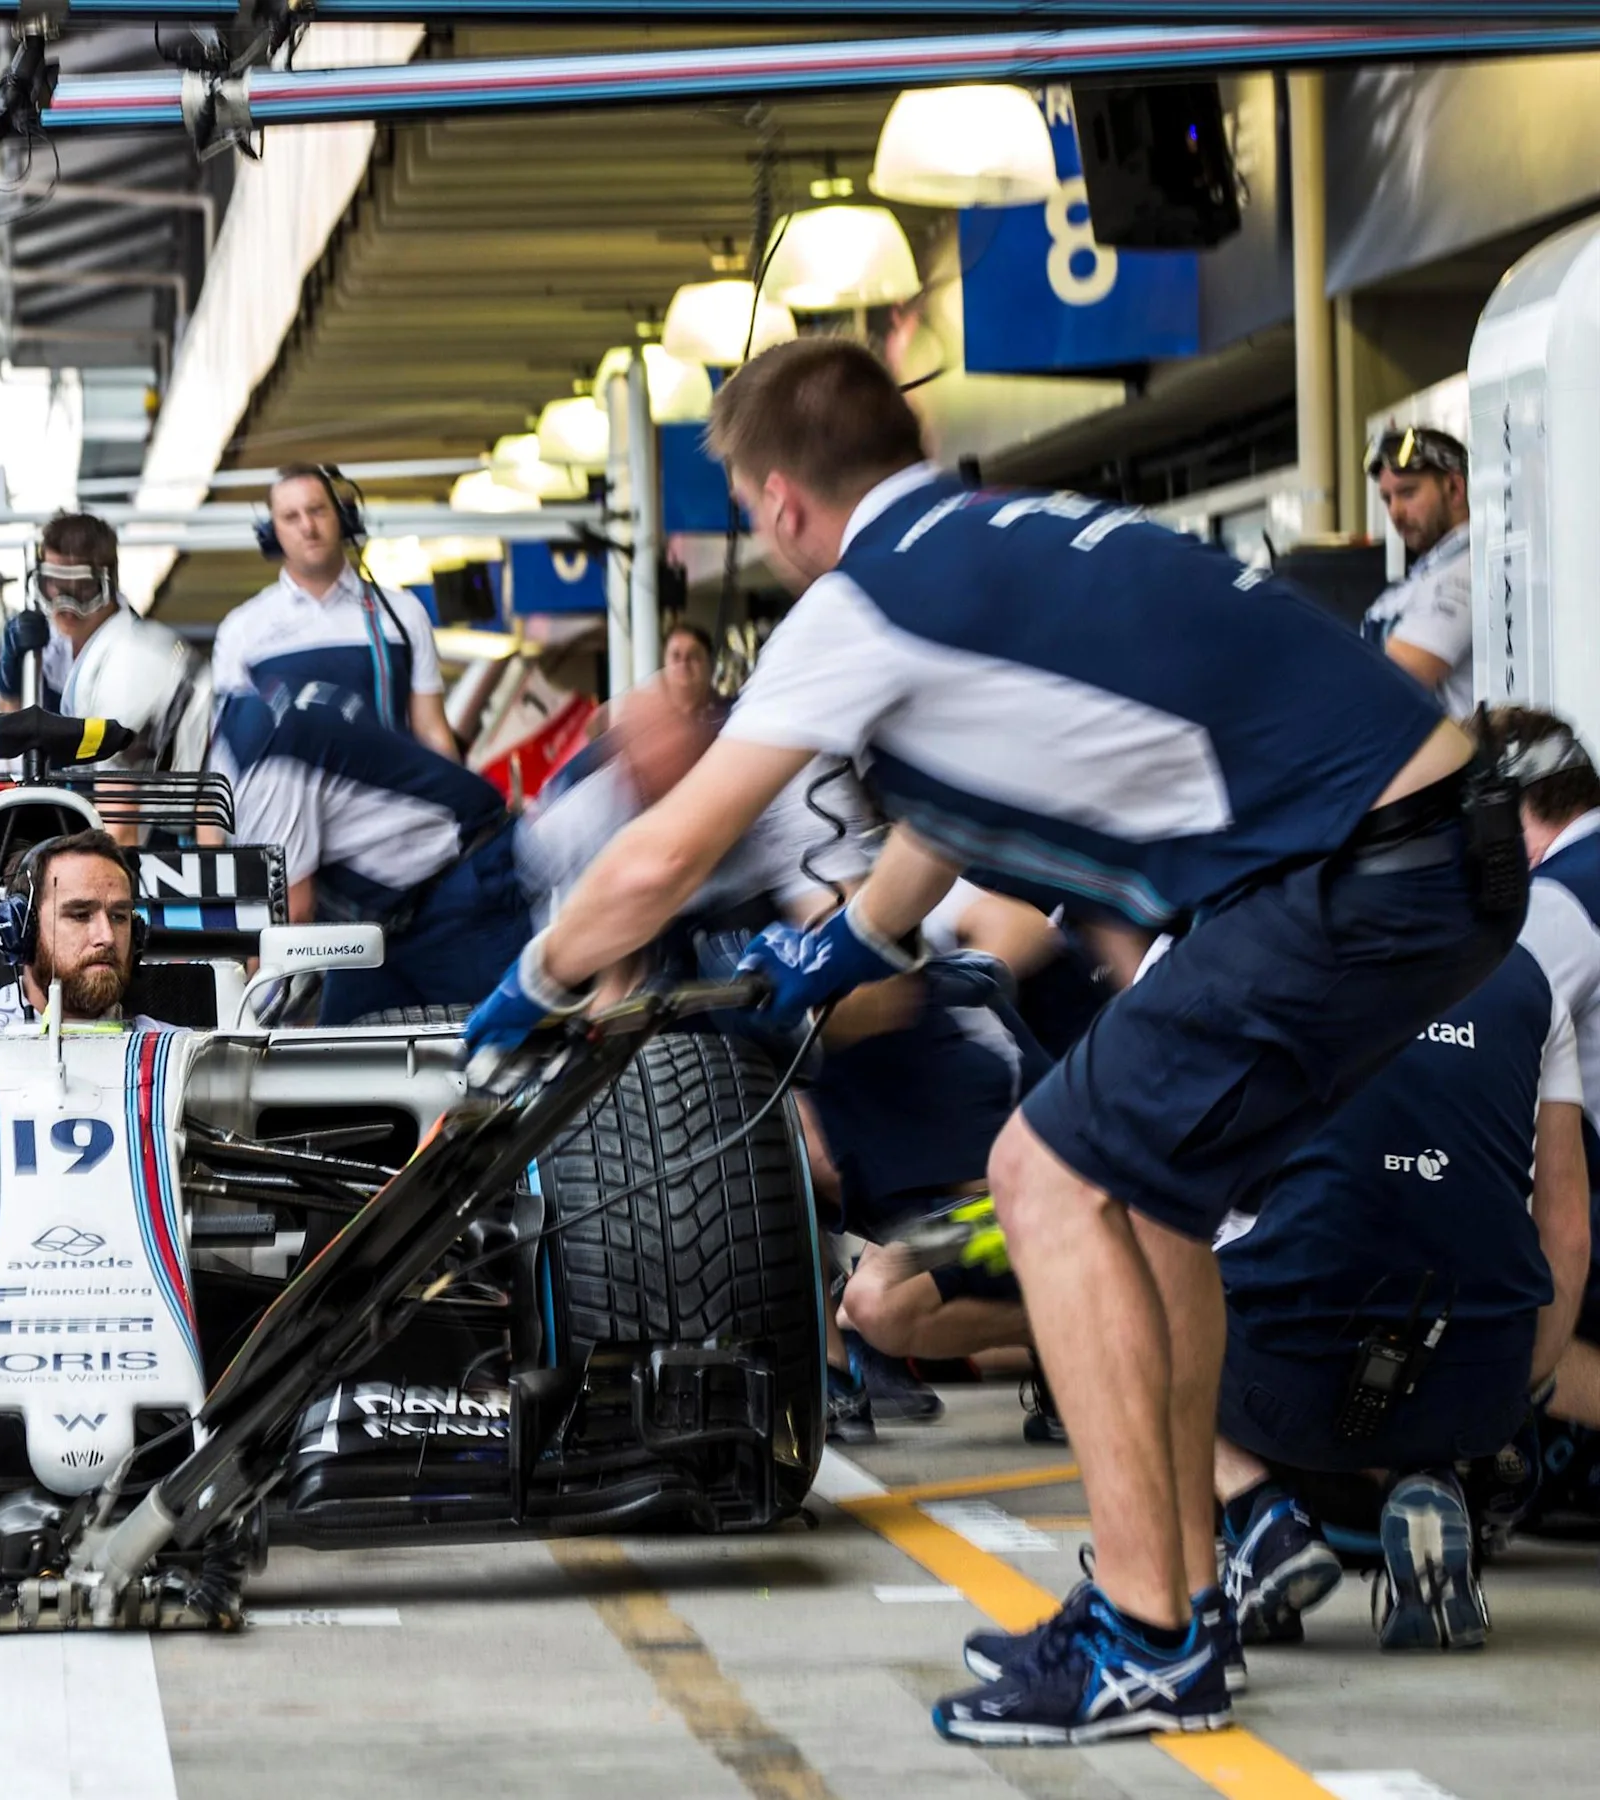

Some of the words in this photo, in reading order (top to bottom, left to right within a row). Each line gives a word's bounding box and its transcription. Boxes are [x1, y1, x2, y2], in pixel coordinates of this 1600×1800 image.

[1044, 177, 1119, 307] 8
[286, 944, 365, 956] #WILLIAMS40
[12, 1118, 115, 1176] 19
[1384, 1154, 1416, 1173] BT
[7, 1257, 134, 1271] avanade
[66, 1372, 160, 1384] Watches
